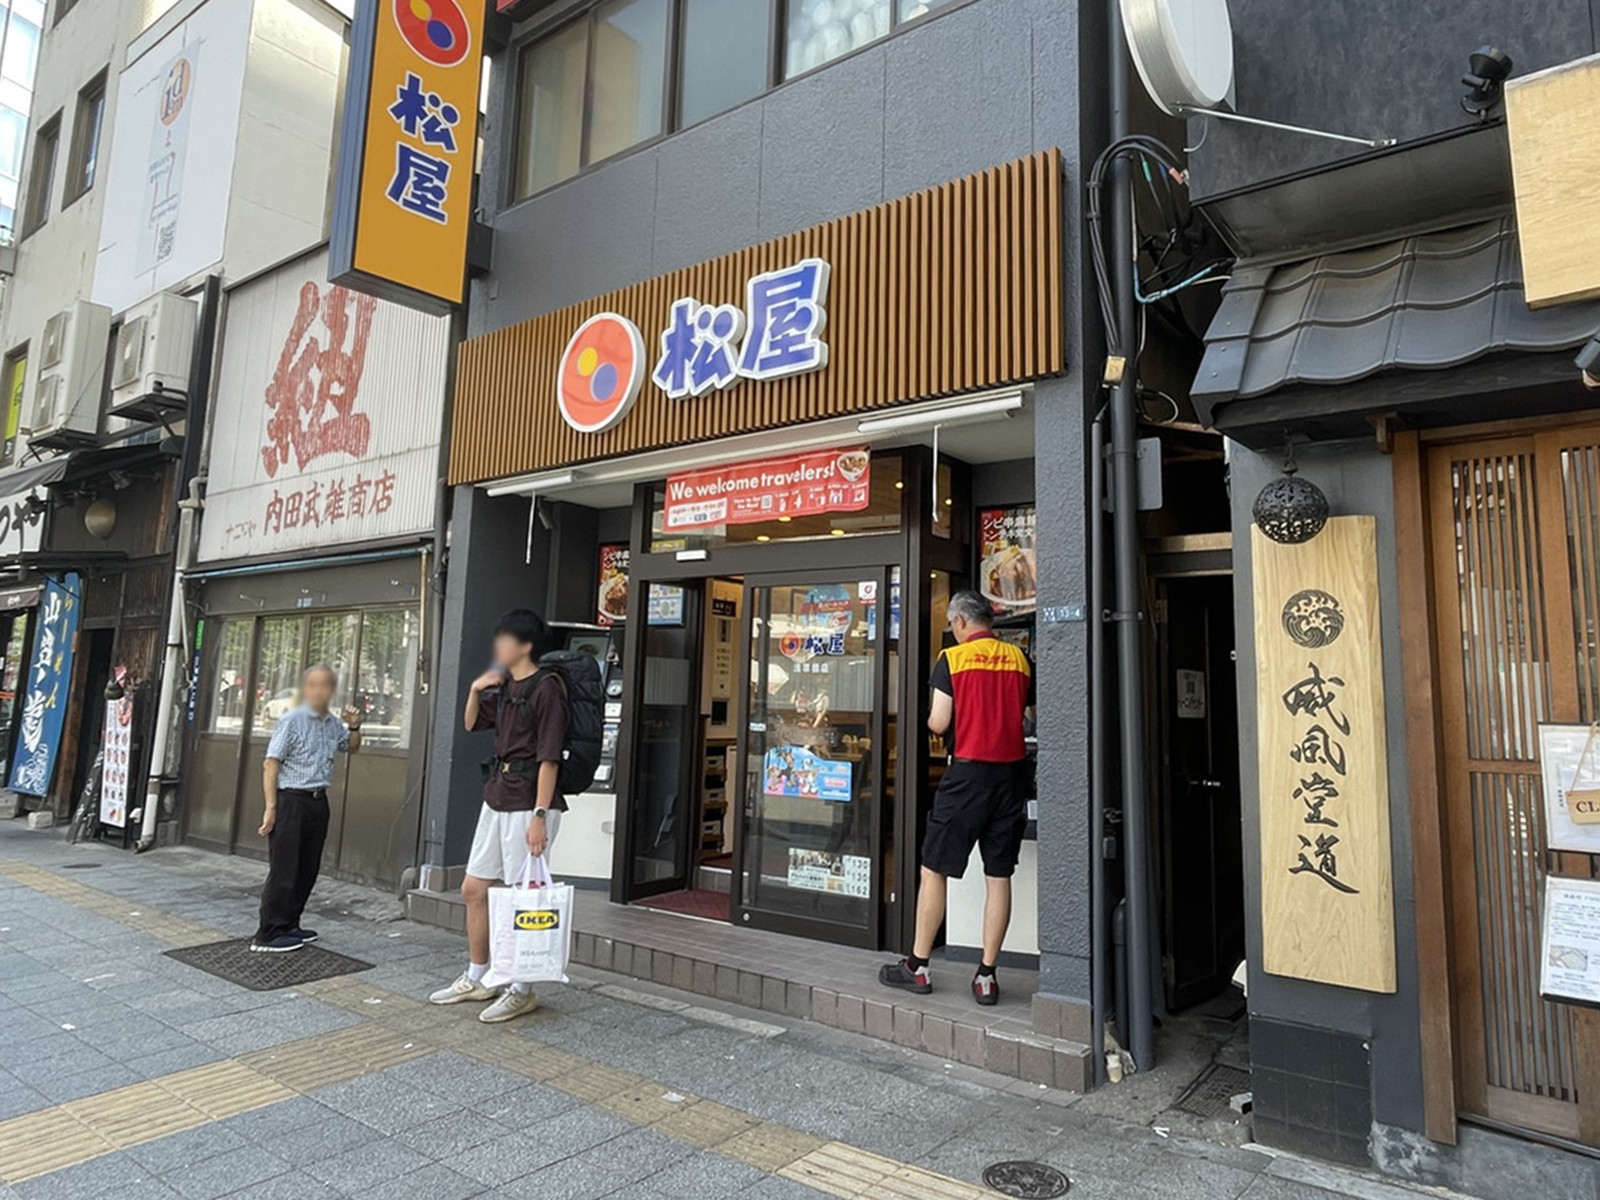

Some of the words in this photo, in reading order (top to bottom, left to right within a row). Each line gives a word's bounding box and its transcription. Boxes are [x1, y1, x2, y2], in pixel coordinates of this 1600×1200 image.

[385, 71, 460, 226] 松屋
[653, 259, 828, 399] 松屋
[669, 482, 693, 501] We
[696, 476, 759, 496] welcome
[761, 460, 835, 487] travelers!
[263, 469, 396, 536] 内田武雄商店
[803, 632, 845, 655] 松屋
[1576, 800, 1600, 814] CL
[519, 915, 555, 924] IKEA
